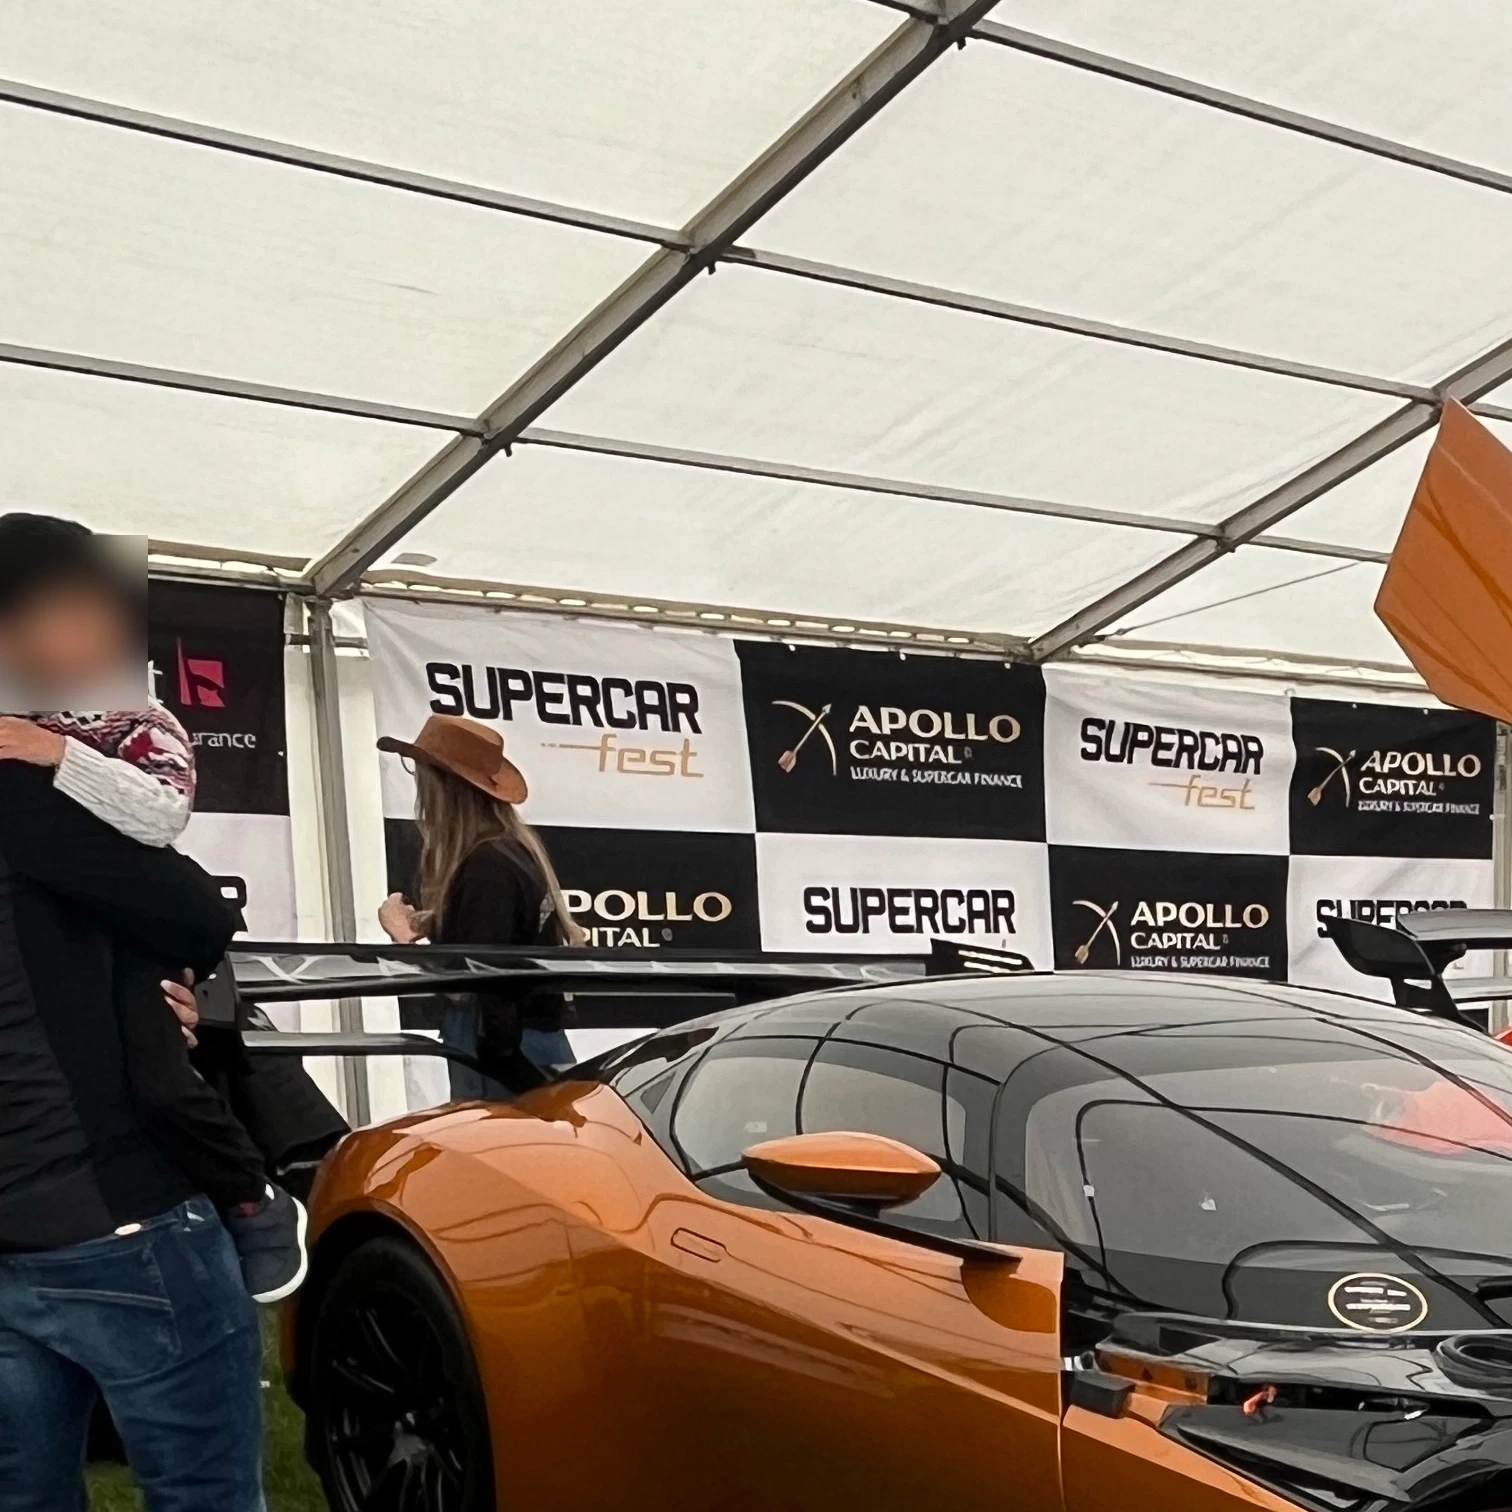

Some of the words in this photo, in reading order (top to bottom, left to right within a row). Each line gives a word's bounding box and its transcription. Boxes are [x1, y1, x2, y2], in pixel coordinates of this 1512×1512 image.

[425, 662, 703, 735] SUPERCAR
[849, 704, 1021, 744] APOLLO
[597, 733, 705, 778] fest
[849, 739, 963, 764] CAPITAL
[1080, 717, 1265, 775] SUPERCAR
[1360, 745, 1482, 778] APOLLO
[1183, 774, 1256, 811] fest
[559, 889, 733, 922] POLLO
[803, 886, 1017, 934] SUPERCAR
[1130, 900, 1270, 929] APOLLO
[1130, 931, 1221, 951] CAPITAL
